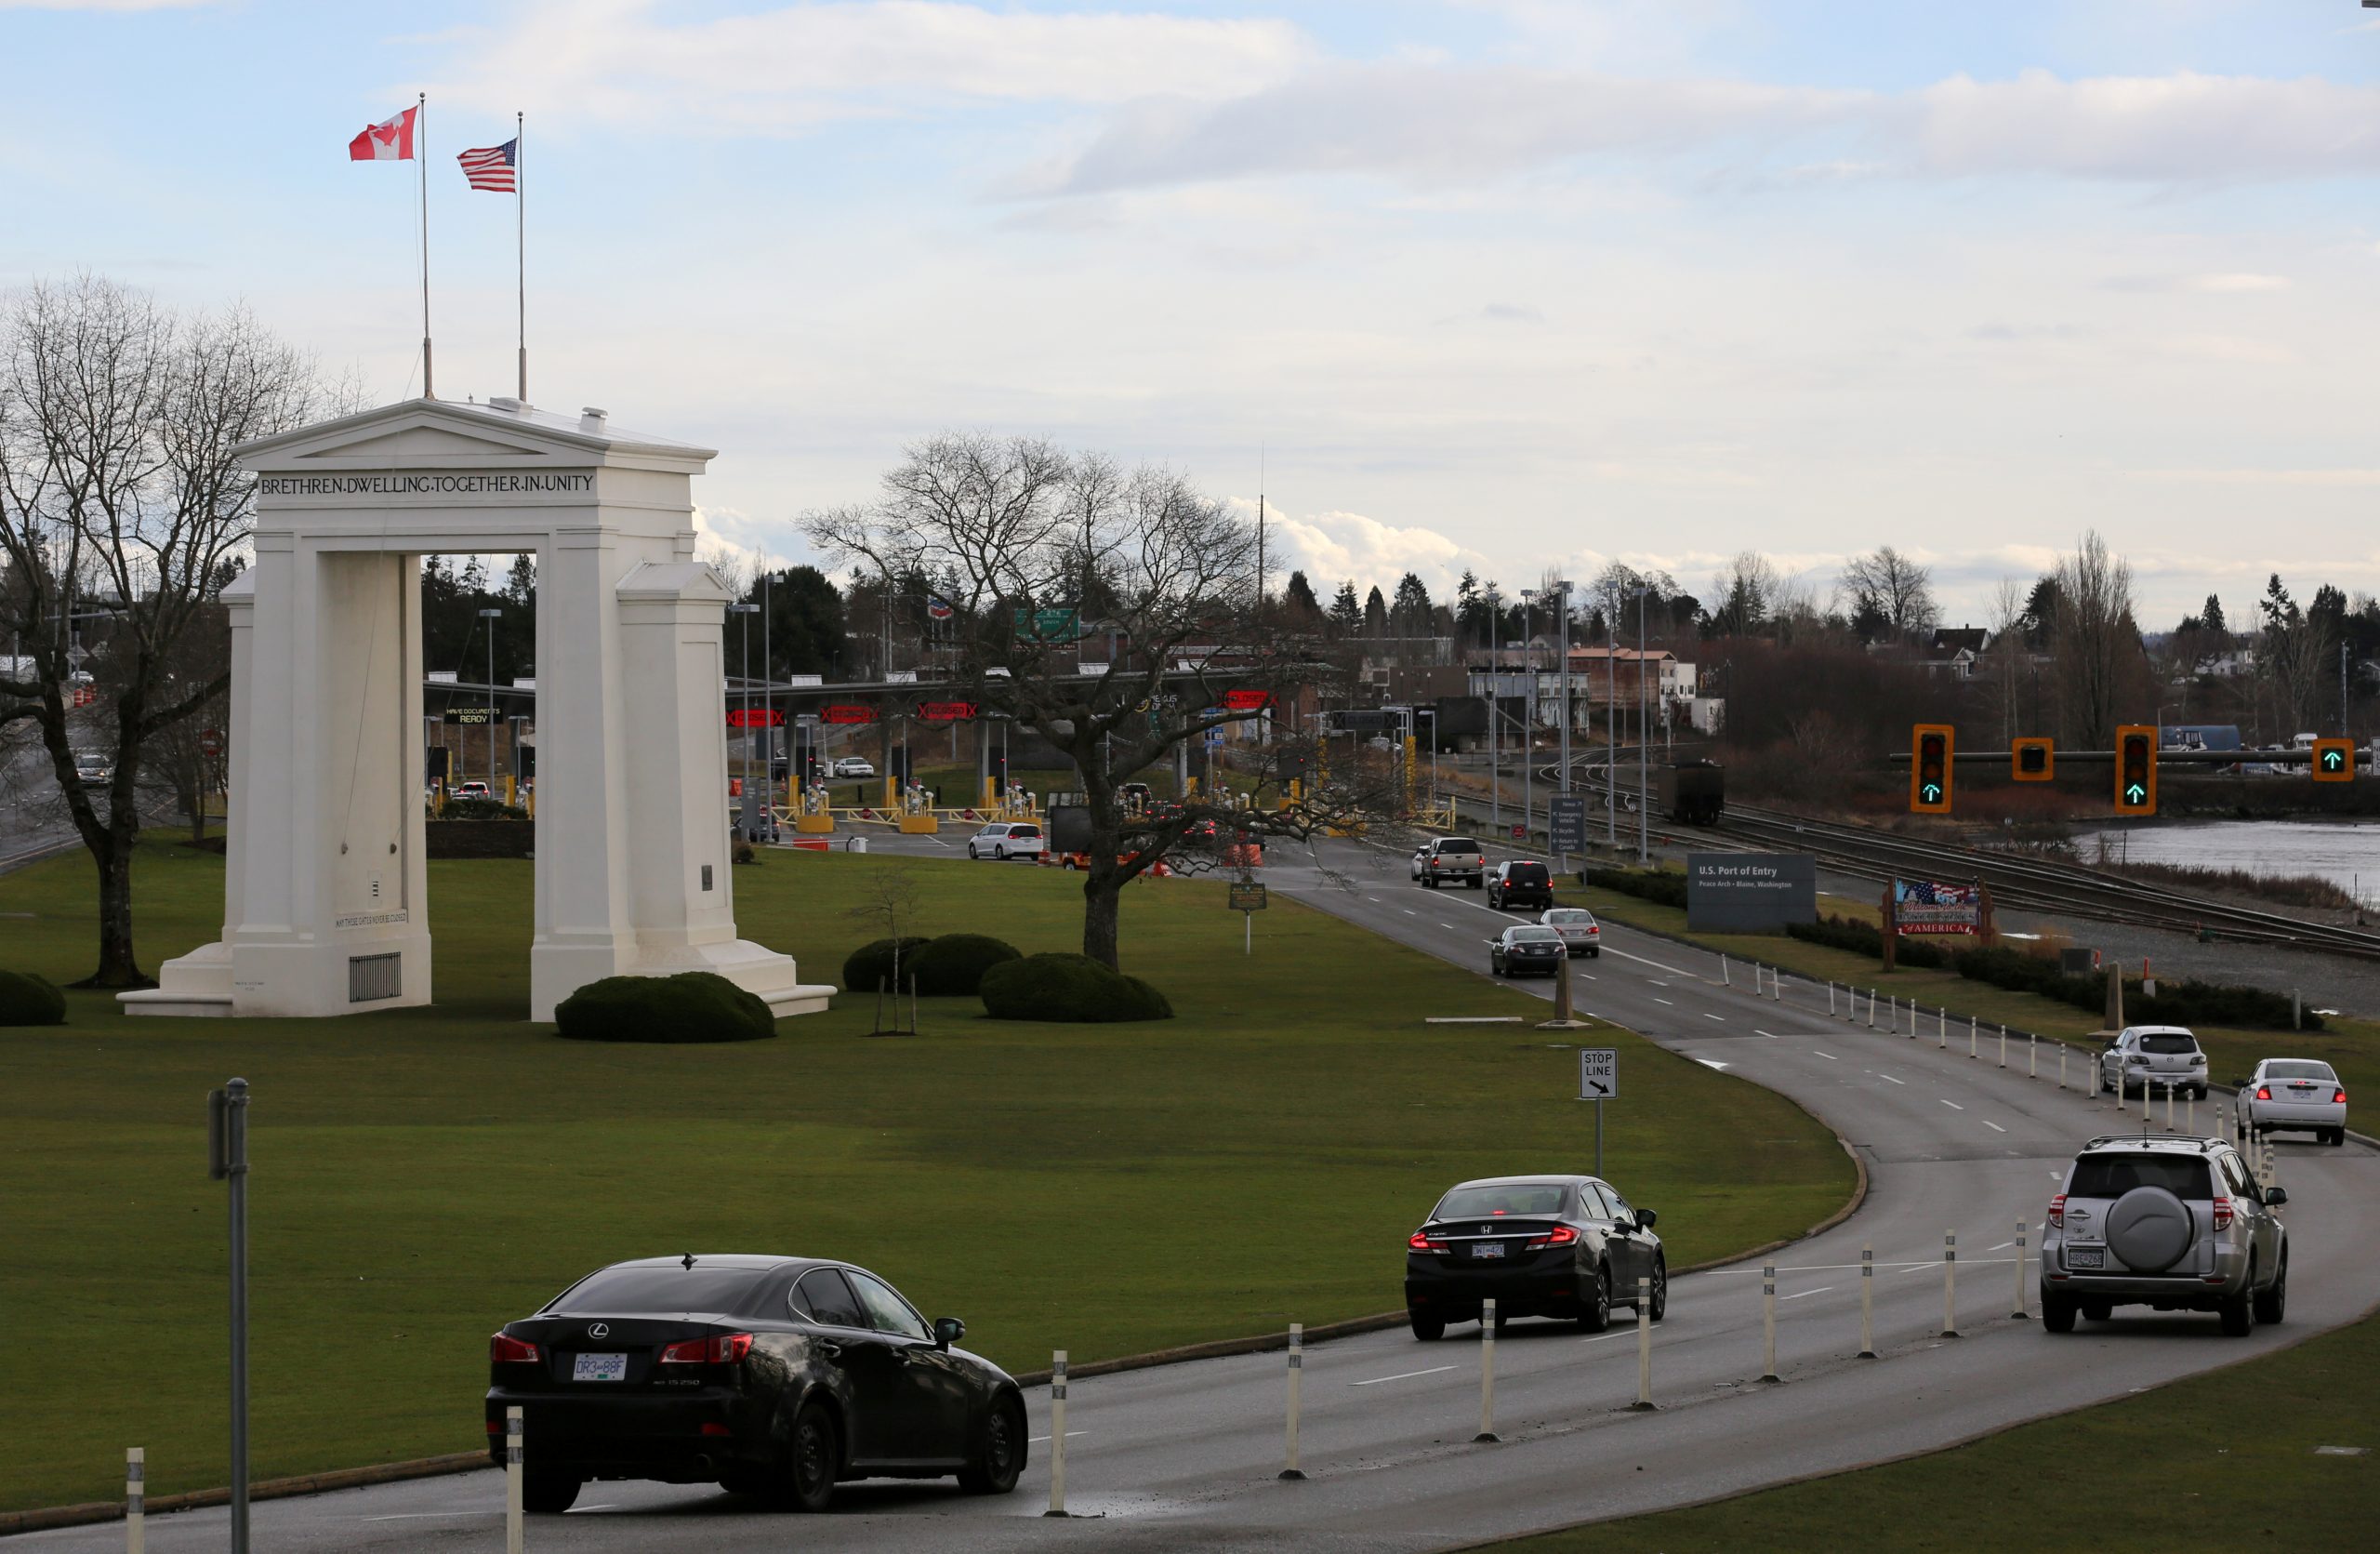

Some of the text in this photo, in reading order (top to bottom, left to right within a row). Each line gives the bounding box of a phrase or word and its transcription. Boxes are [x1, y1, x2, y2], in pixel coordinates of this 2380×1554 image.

[261, 475, 593, 495] BRETHREN DWELLING TOGETHER IN UNITY
[1699, 866, 1778, 878] U.S. Port of Entry
[1736, 881, 1756, 889] Blaine,
[1757, 881, 1792, 890] Washington
[1904, 900, 1939, 910] Welcome
[1584, 1054, 1612, 1063] STOP
[1586, 1066, 1611, 1076] LINE
